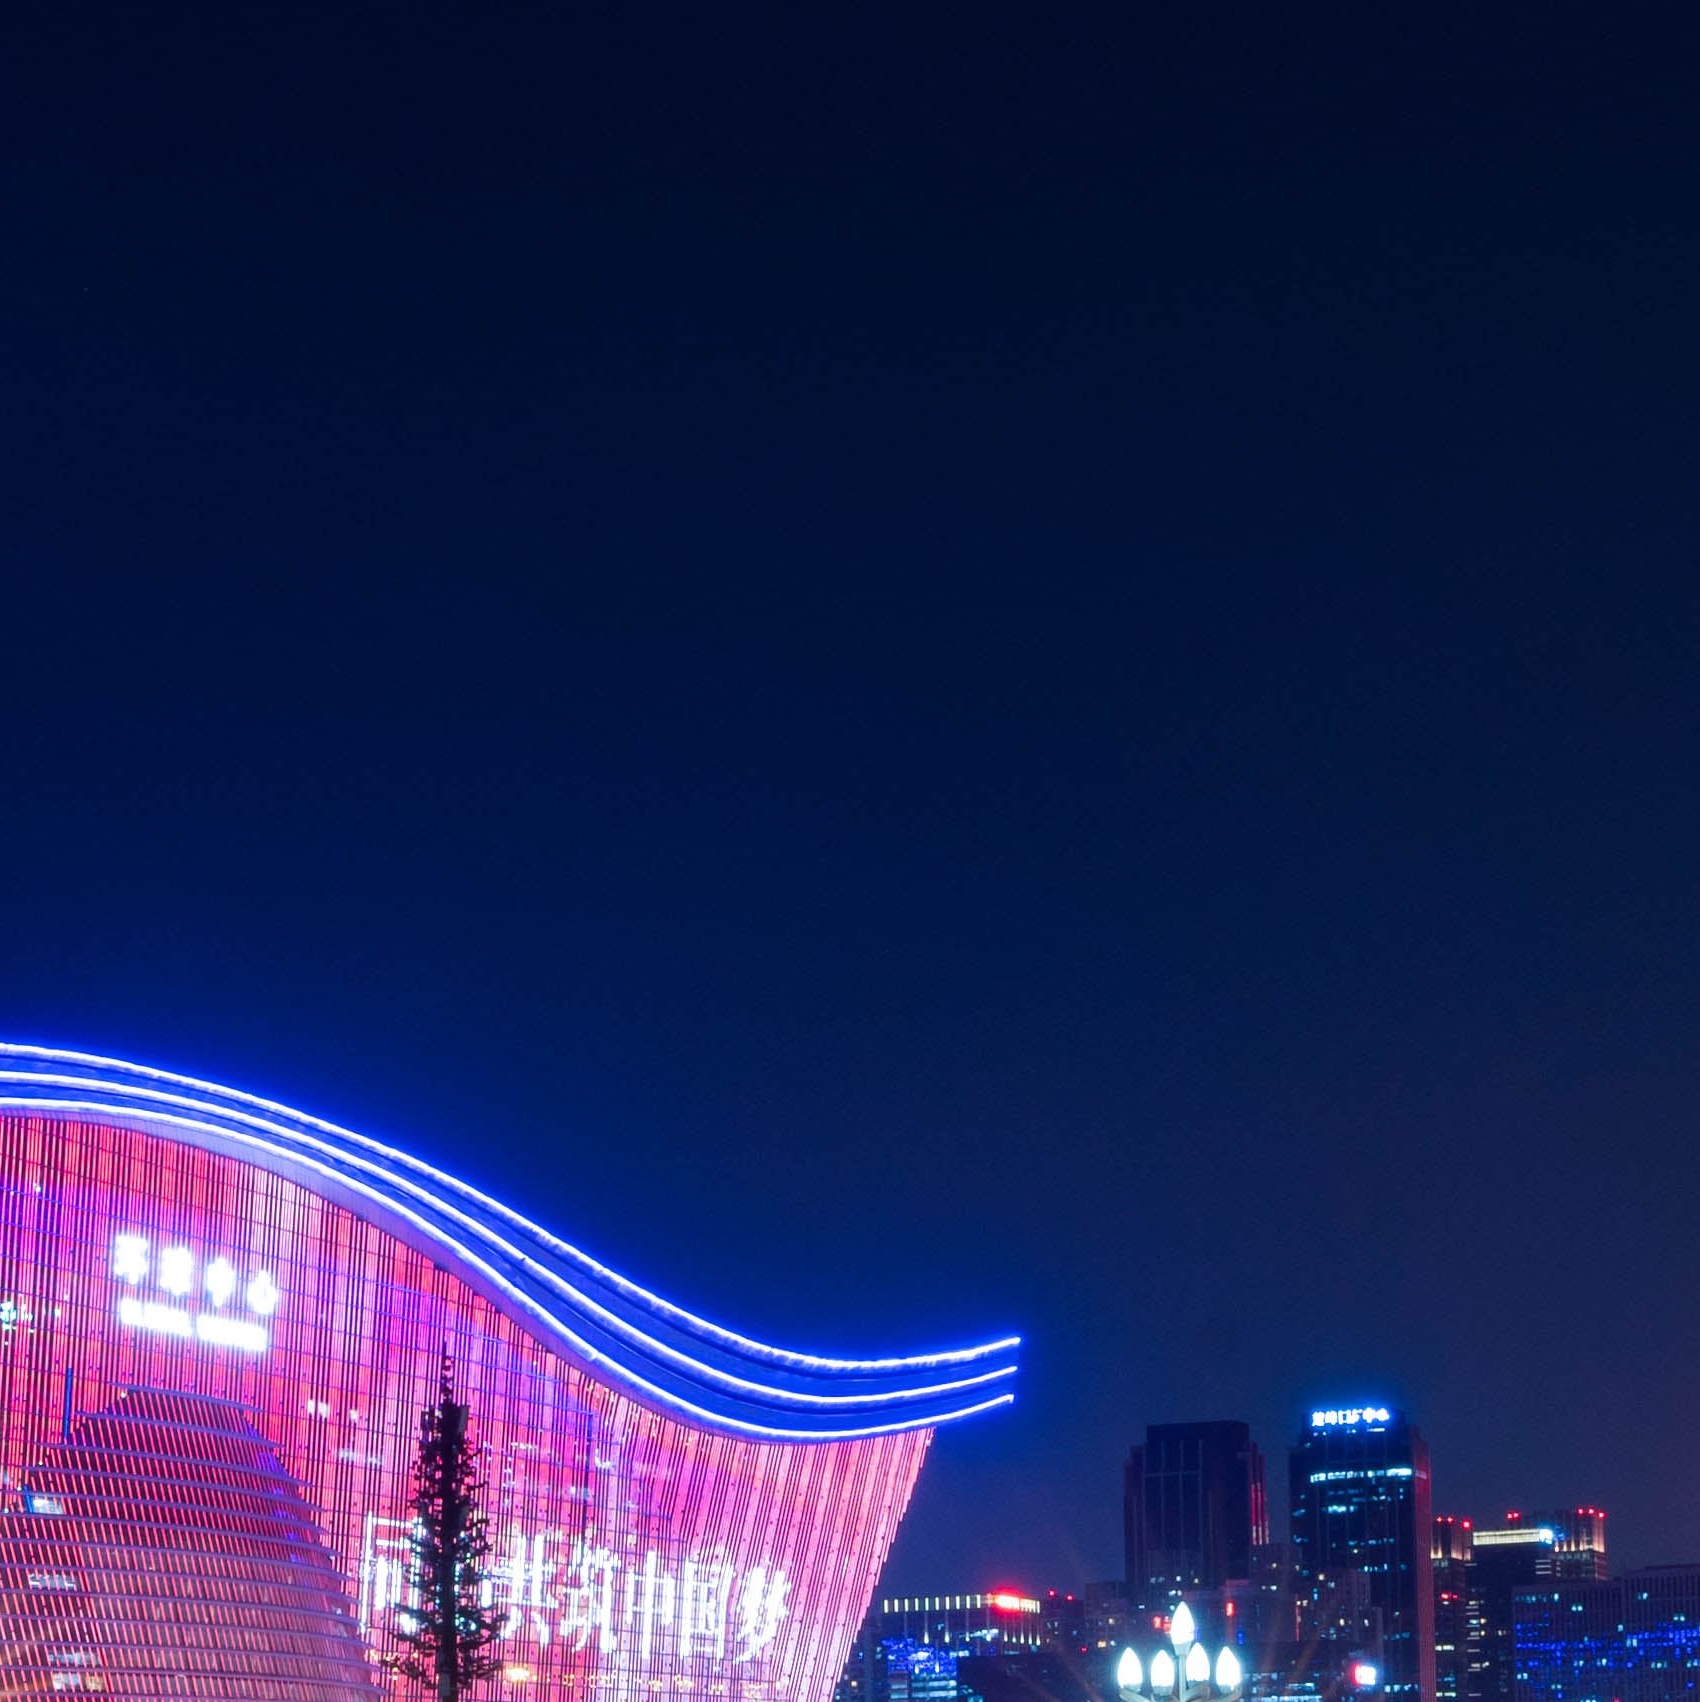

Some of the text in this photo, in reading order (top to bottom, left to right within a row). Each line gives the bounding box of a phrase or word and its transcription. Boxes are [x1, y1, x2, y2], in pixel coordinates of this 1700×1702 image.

[359, 1511, 793, 1665] 同共筑中国梦
